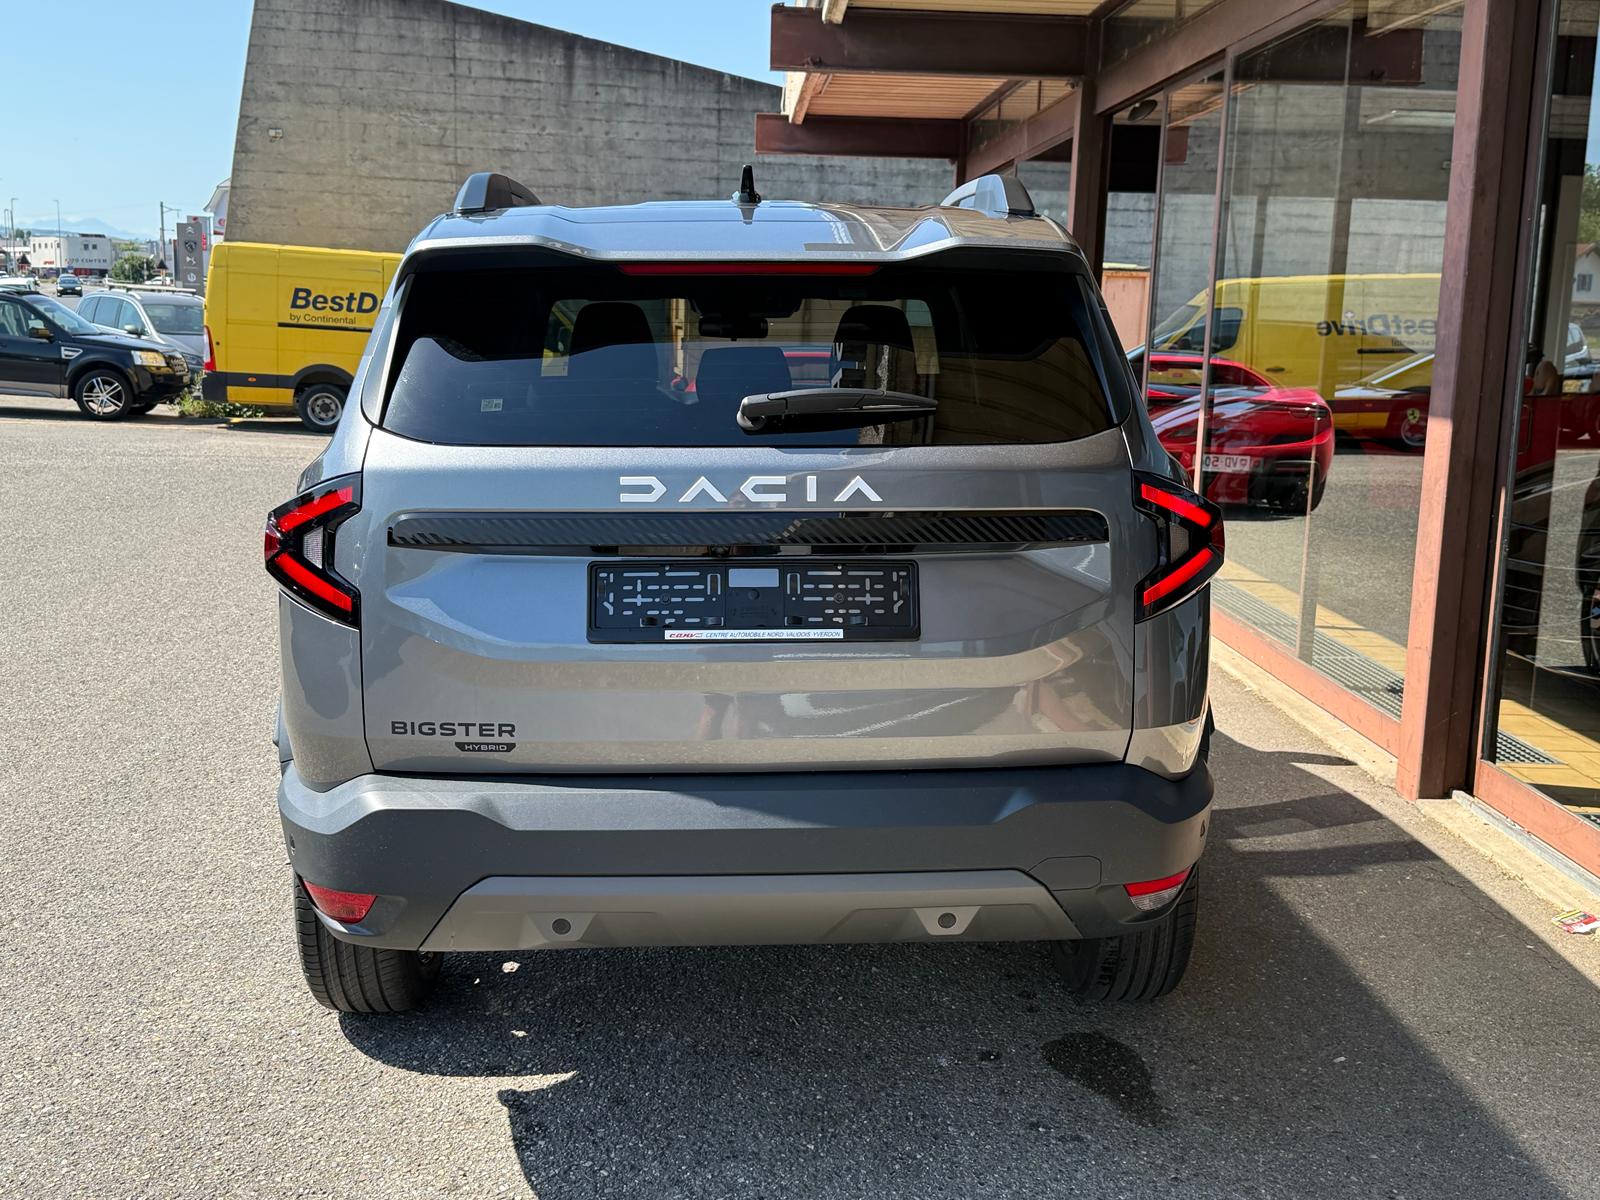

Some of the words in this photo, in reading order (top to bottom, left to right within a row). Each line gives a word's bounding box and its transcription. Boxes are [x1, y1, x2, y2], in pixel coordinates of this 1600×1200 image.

[290, 312, 301, 323] by
[303, 313, 356, 325] Continental
[619, 475, 884, 502] DACIA
[391, 720, 516, 738] BIGSTER
[464, 743, 507, 751] HYBRID
